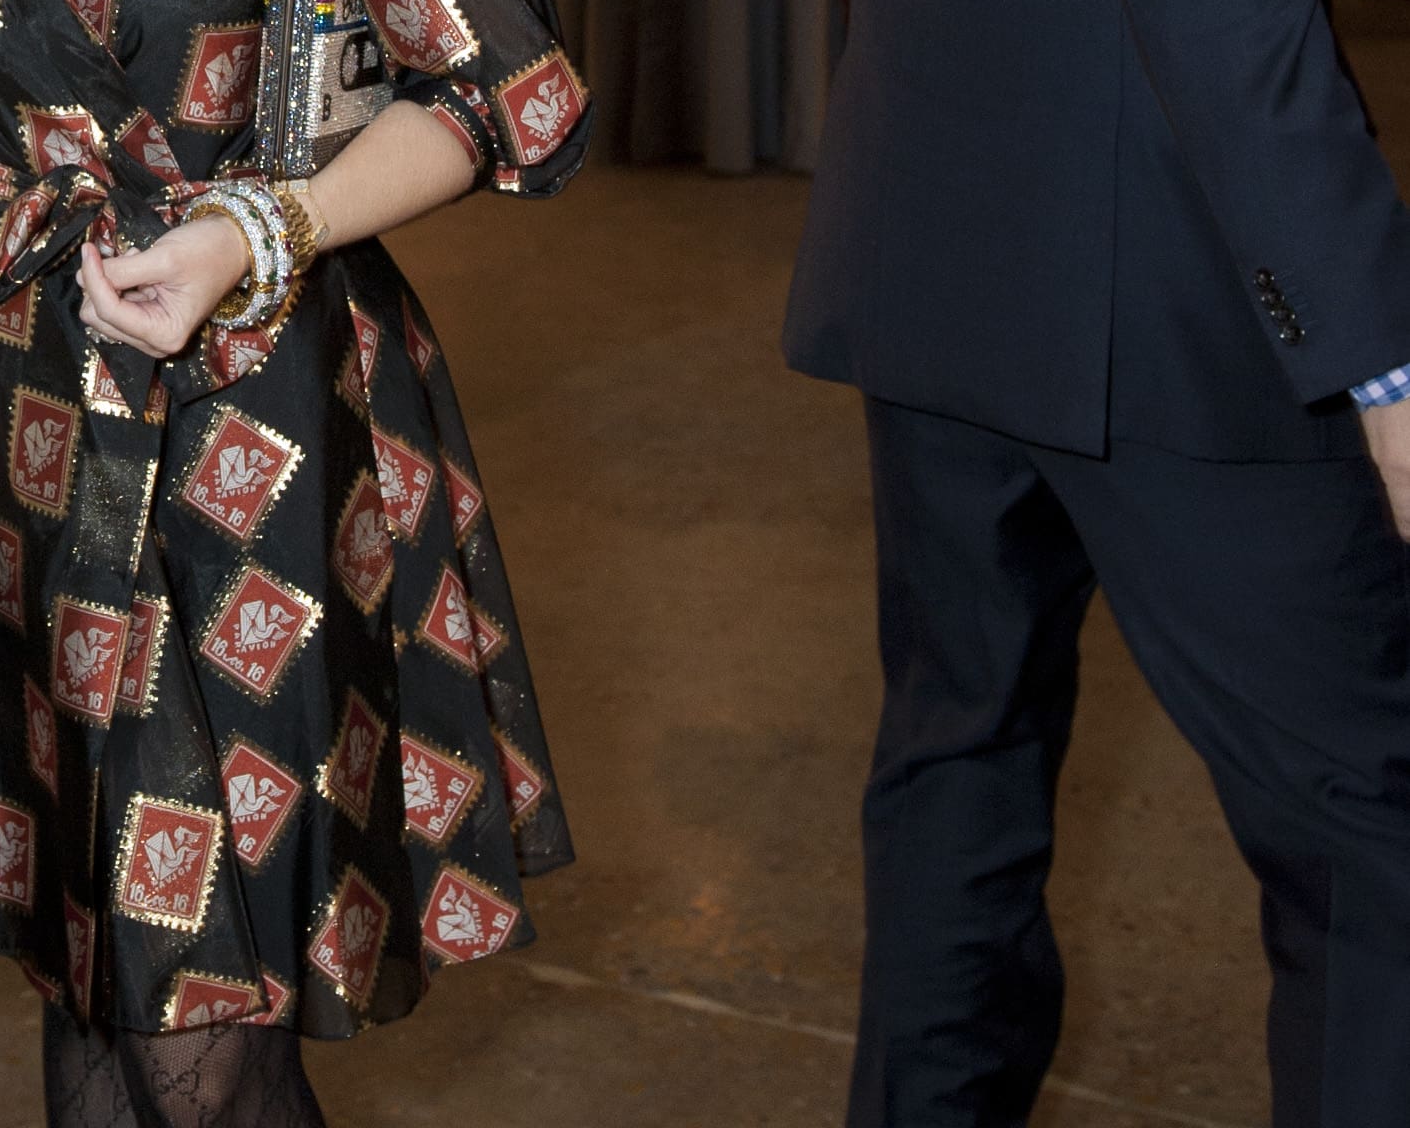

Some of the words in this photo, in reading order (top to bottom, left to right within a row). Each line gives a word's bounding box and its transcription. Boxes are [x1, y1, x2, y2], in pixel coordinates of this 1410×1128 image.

[437, 31, 456, 52] 16
[189, 102, 204, 118] 16
[525, 145, 541, 161] 16
[10, 312, 21, 329] 16
[361, 328, 375, 346] 16
[43, 481, 57, 499] 16
[400, 509, 414, 526] 16
[413, 468, 428, 487] 16
[192, 483, 209, 502] 16
[228, 507, 246, 527] 16
[459, 495, 474, 512] 16
[210, 637, 228, 656] 16
[247, 662, 265, 682] 16
[122, 677, 137, 695] 16
[88, 692, 103, 710] 16
[515, 781, 534, 797] 16
[427, 816, 444, 833] 16
[447, 777, 466, 796] 16
[231, 813, 267, 824] AVION
[237, 834, 256, 853] 16
[129, 882, 145, 902] 16
[173, 893, 189, 913] 16
[492, 912, 509, 930] 16
[316, 944, 333, 965] 16
